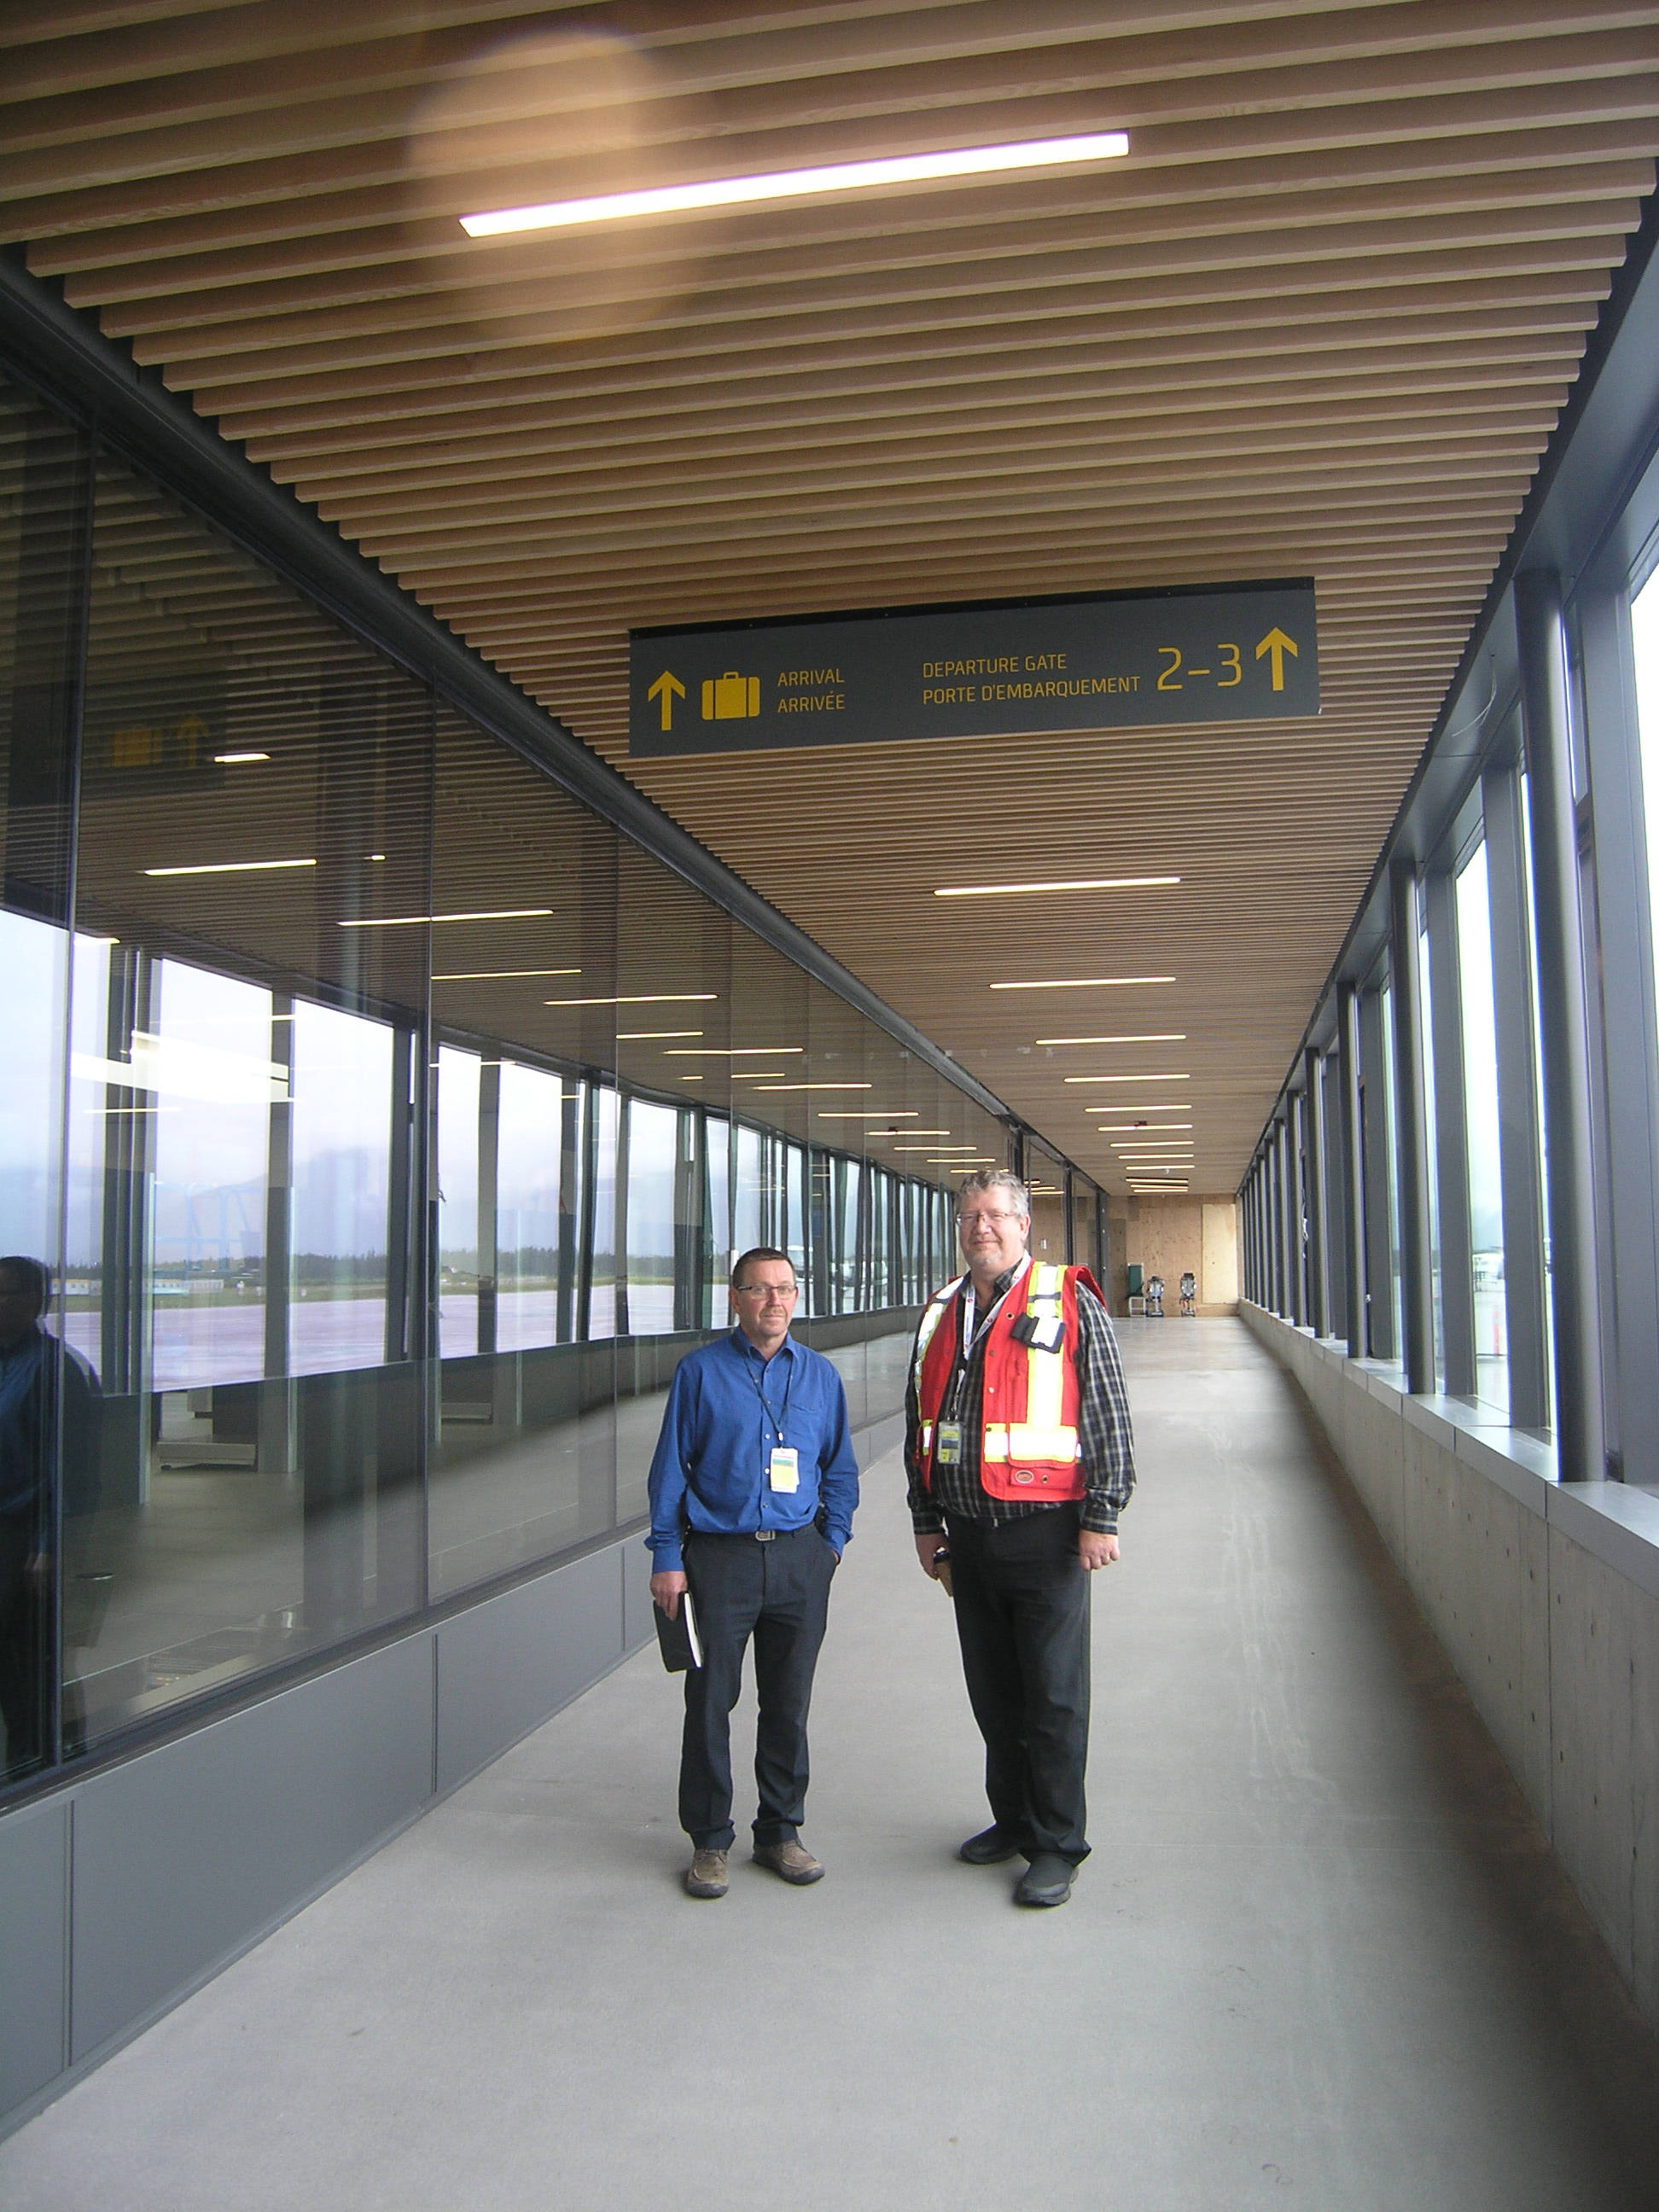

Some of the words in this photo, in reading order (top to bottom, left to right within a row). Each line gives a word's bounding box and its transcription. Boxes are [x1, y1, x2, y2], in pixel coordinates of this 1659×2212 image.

[777, 668, 845, 687] ARRIVAL
[922, 656, 1019, 678] DEPARTURE
[1024, 653, 1067, 672] GATE
[776, 690, 846, 713] ARRIVÉE
[922, 684, 975, 705] PORTE
[981, 675, 1141, 702] D'EMBARQUEMENT
